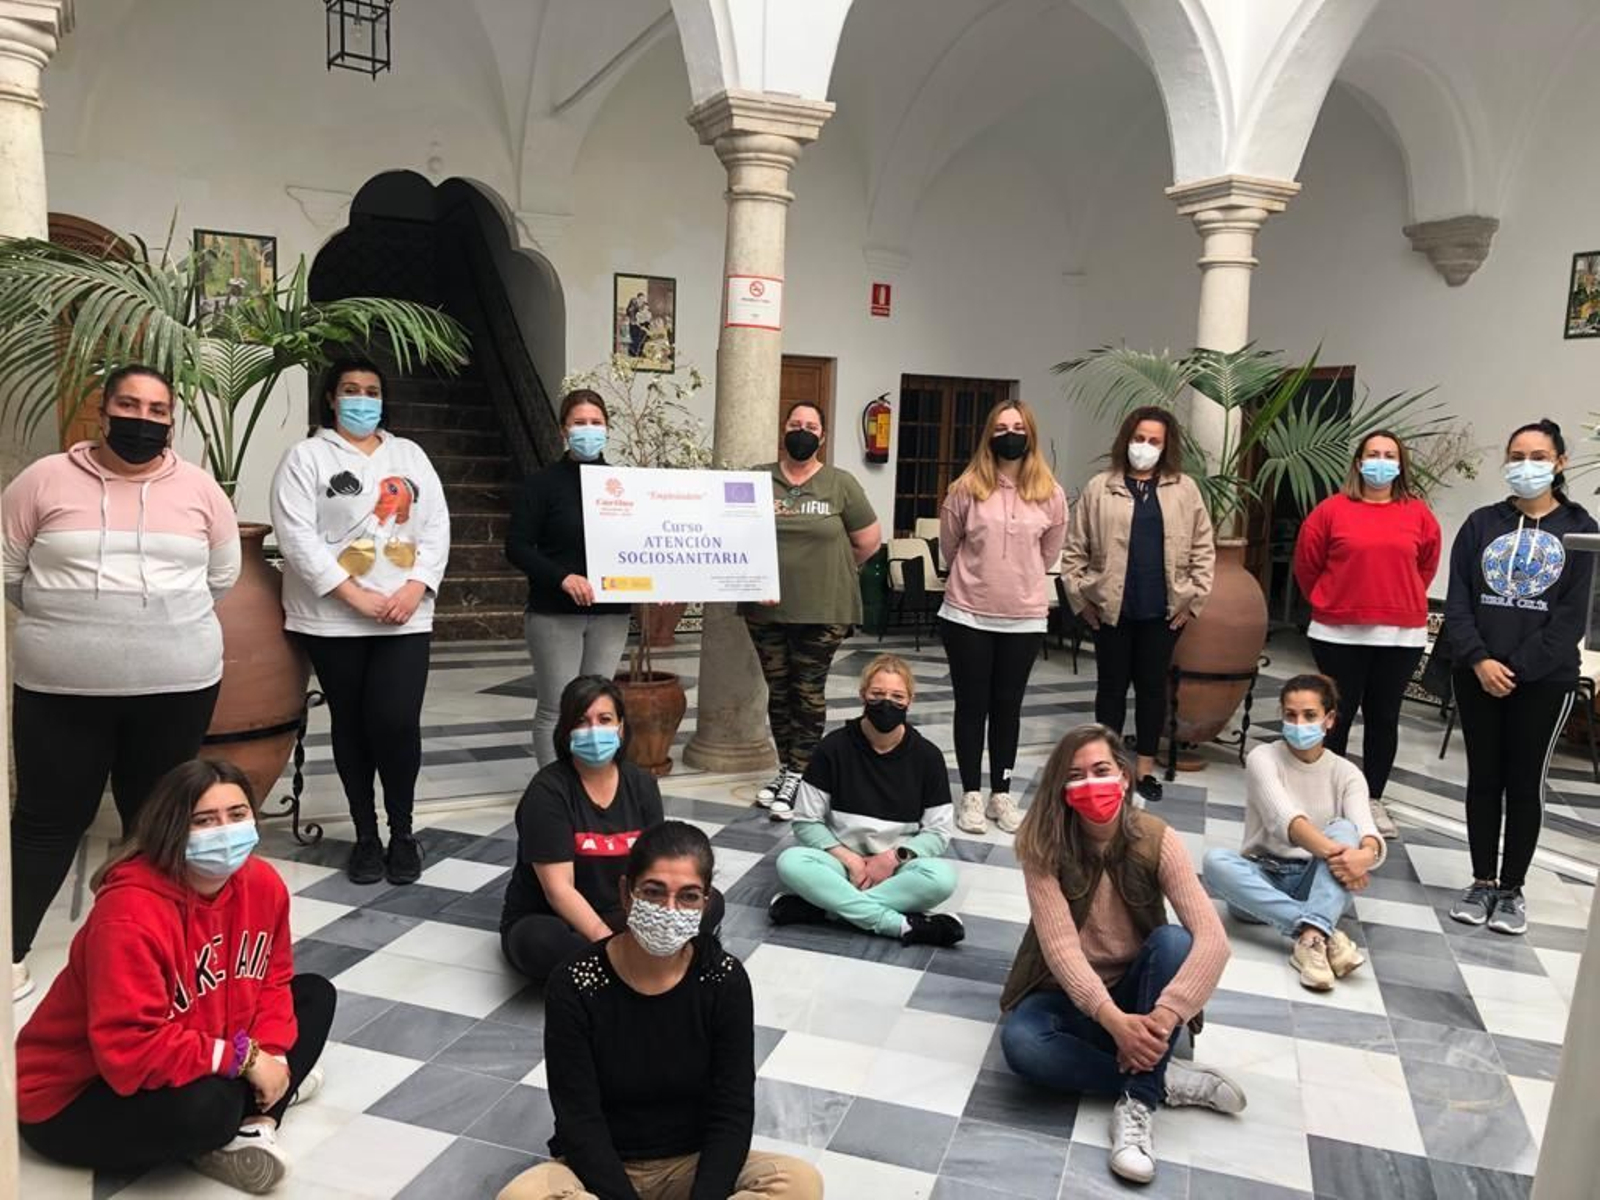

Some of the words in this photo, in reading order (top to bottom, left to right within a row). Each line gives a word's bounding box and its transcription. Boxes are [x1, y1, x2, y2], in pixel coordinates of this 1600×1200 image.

[662, 519, 703, 533] Curso
[643, 532, 723, 549] ATENCIÓN
[617, 551, 750, 565] SOCIOSANITARIA
